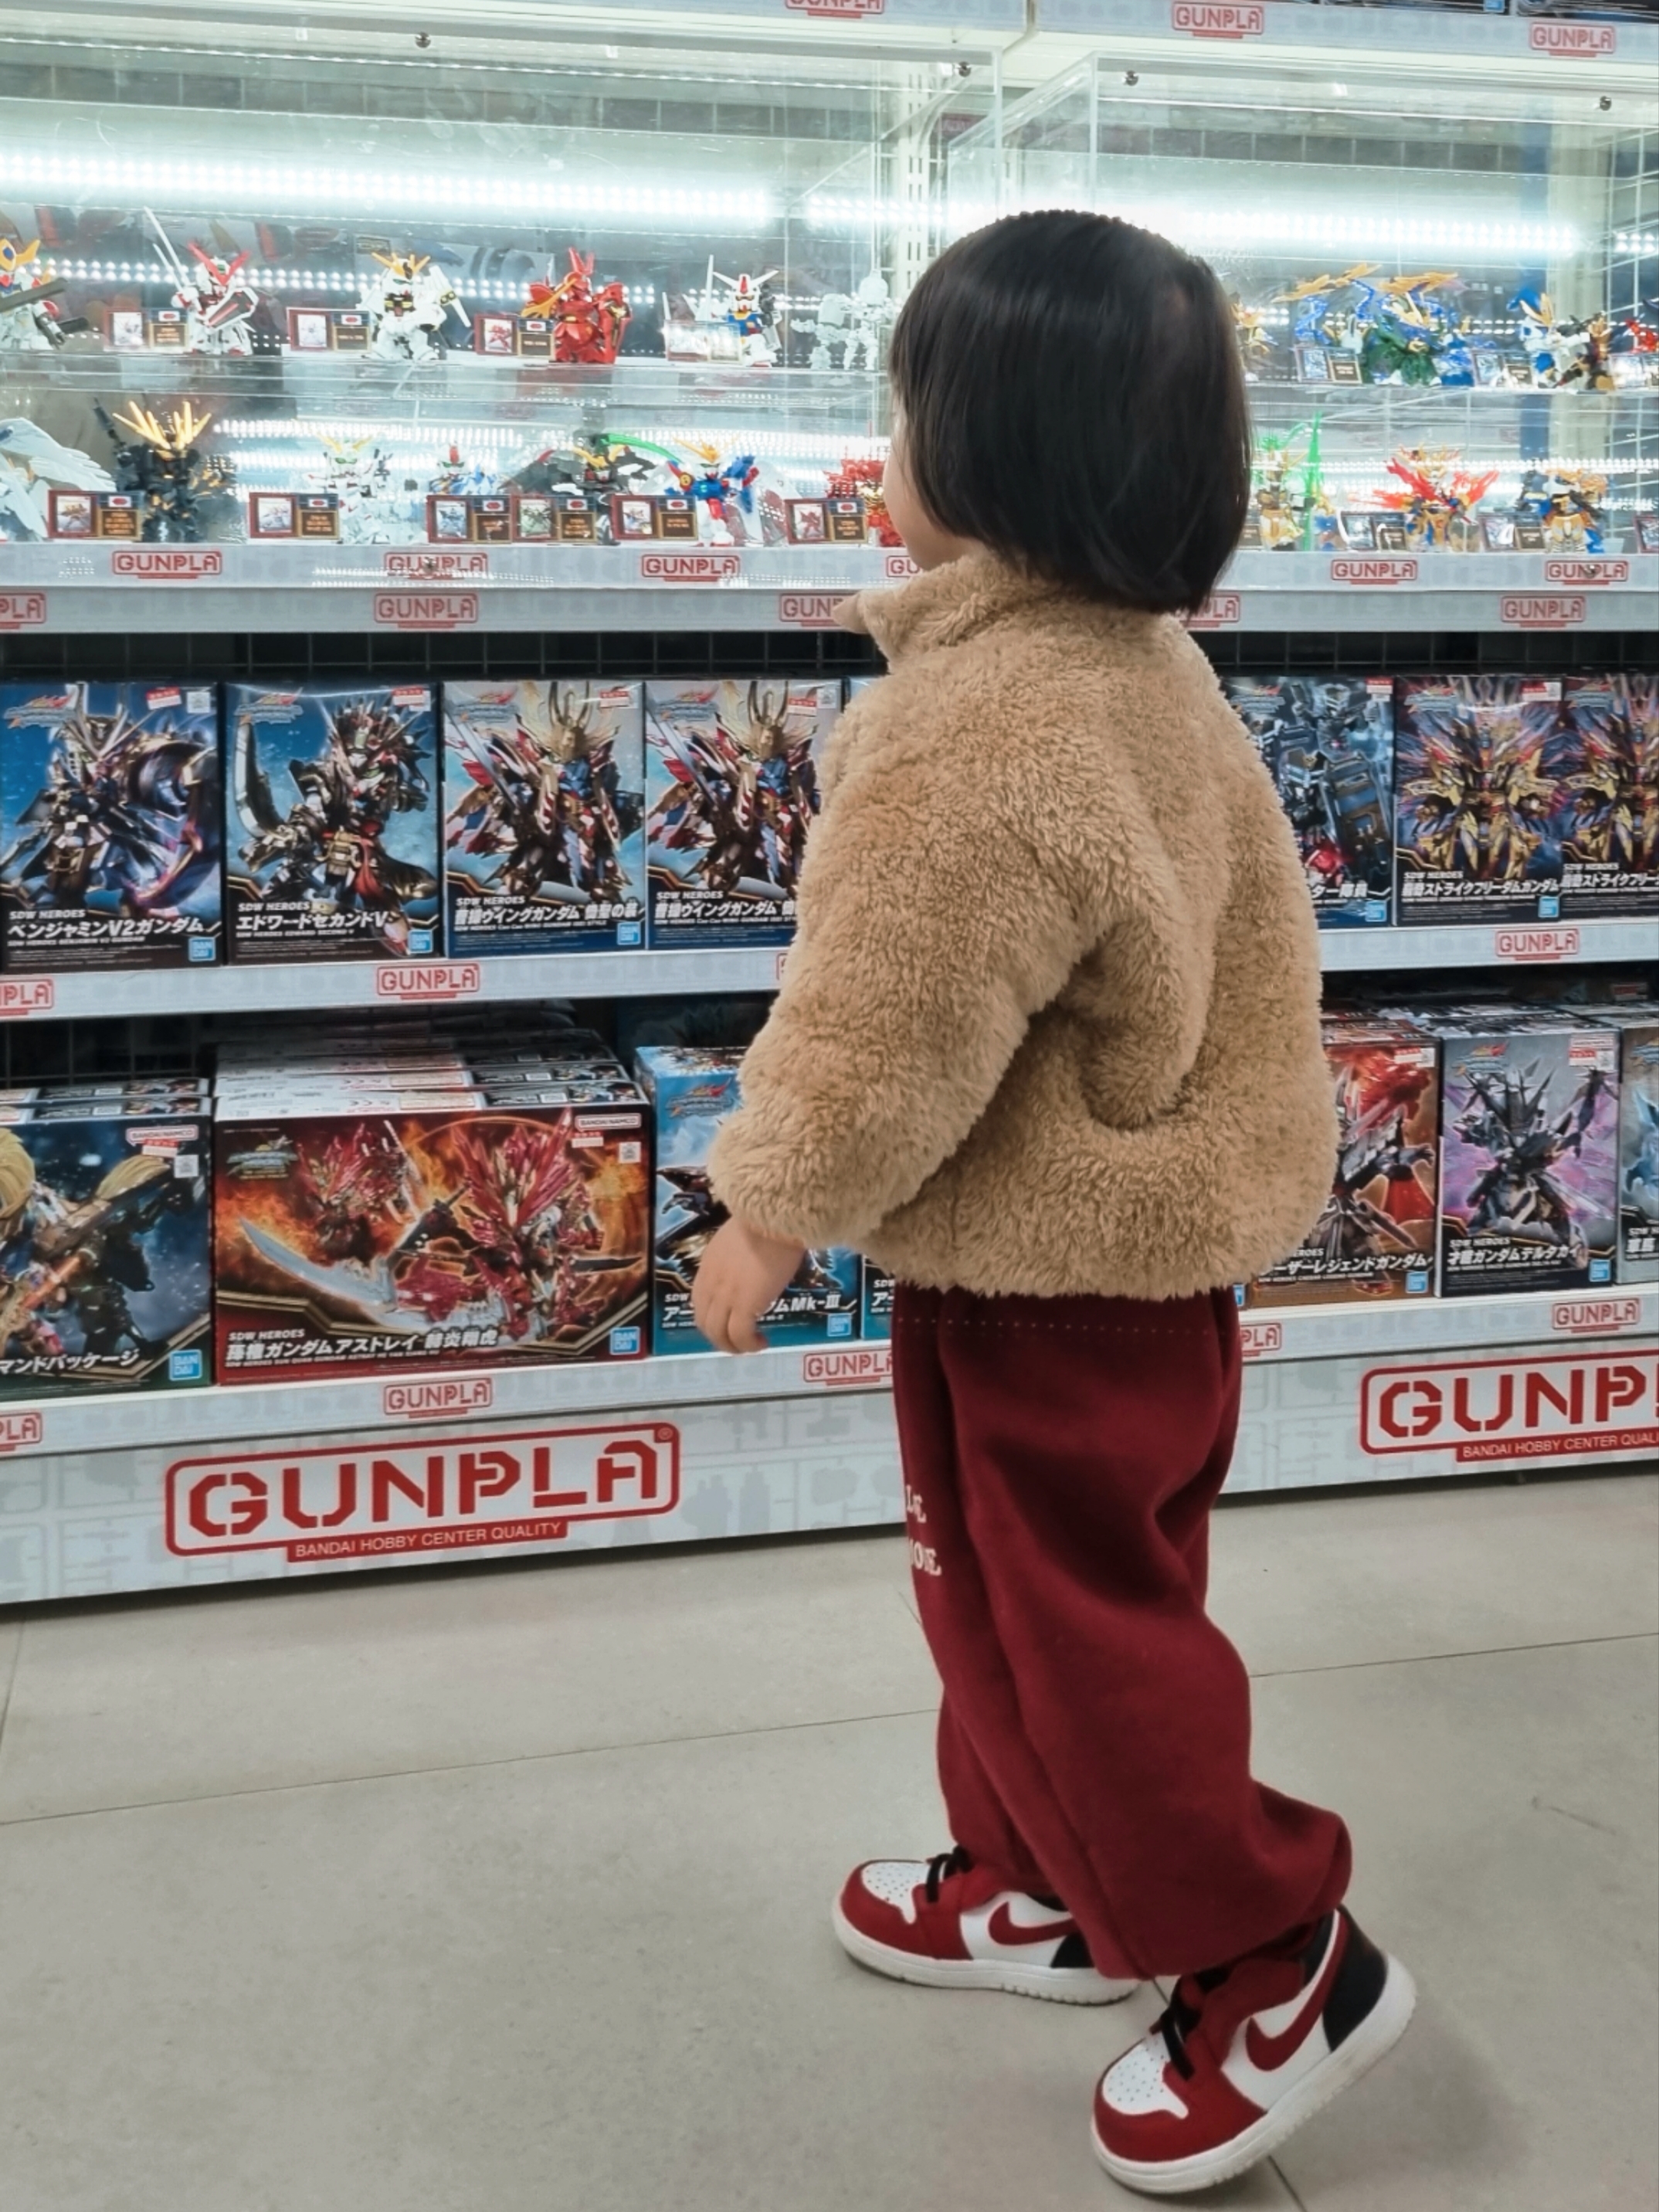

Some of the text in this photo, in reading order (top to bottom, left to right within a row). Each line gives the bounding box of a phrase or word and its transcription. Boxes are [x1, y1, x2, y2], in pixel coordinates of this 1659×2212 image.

[1176, 6, 1260, 29] GUNPLA
[1533, 26, 1612, 49] GUNPLA
[117, 555, 217, 571] GUNPLA
[646, 558, 736, 574] GUNPLA
[1334, 562, 1414, 578] GUNPLA
[1549, 564, 1625, 578] GUNPLA
[378, 598, 476, 619] GUNPLA
[1505, 600, 1582, 618] GUNPLA
[456, 896, 525, 907] SDW HEROES
[656, 891, 724, 901] SDW HEROES
[9, 909, 86, 920] SDW HEROES
[238, 901, 310, 912] SDW HEROES
[7, 917, 205, 938] ベンジャミンV2ガンダム
[236, 911, 389, 931] エドワードセカンドV
[1500, 934, 1576, 952] GUNPLA
[382, 969, 475, 991] GUNPLA
[1259, 1254, 1427, 1274] ーザーレジェンドガンダム
[665, 1293, 689, 1302] SDW
[1556, 1304, 1636, 1325] GUNPLA
[229, 1328, 305, 1341] SDW HEROES
[175, 1355, 198, 1366] BAN
[388, 1382, 487, 1410] GUNPLA
[1379, 1366, 1659, 1438] GUNP
[1463, 1444, 1511, 1458] BANDAI
[1515, 1439, 1560, 1454] HOBBY
[1564, 1434, 1617, 1450] CENTER
[190, 1440, 656, 1537] GUNPLA
[295, 1522, 561, 1558] BANDAI HOBBY CENTER QUALITY
